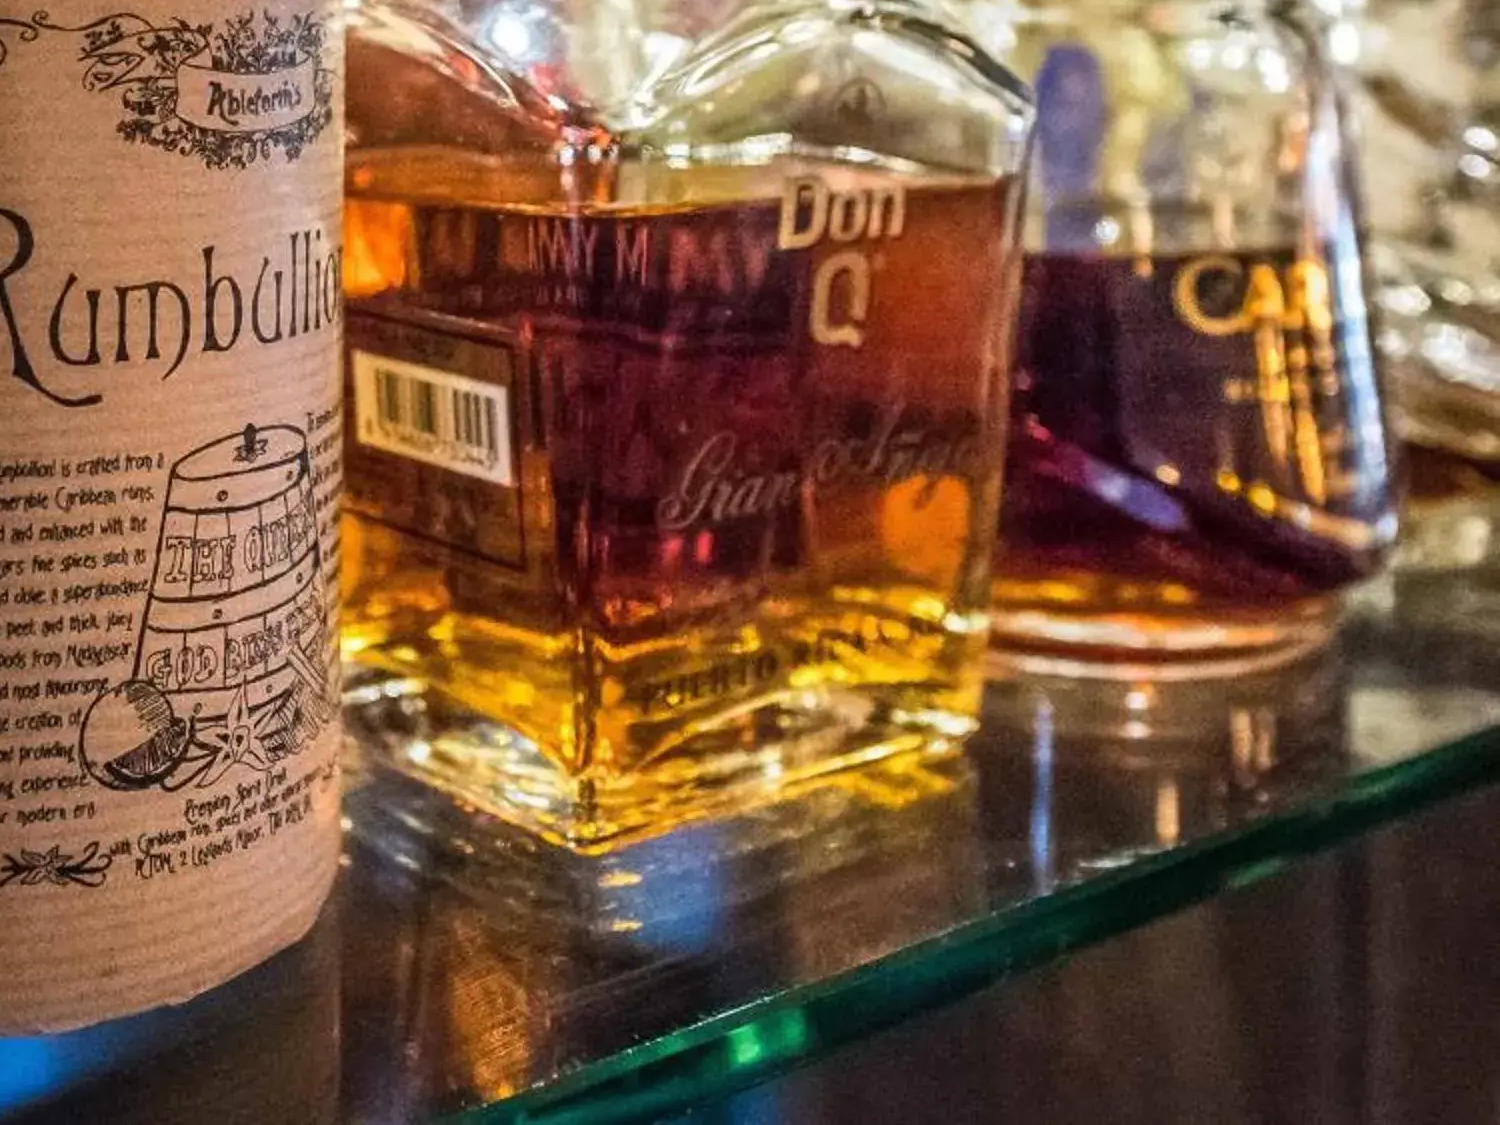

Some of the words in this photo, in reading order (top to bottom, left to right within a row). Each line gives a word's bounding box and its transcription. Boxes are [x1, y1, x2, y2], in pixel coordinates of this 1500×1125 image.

[780, 175, 905, 251] Don
[810, 253, 873, 348] Q
[55, 486, 116, 513] Caribbean
[10, 523, 33, 542] and
[99, 517, 124, 535] with
